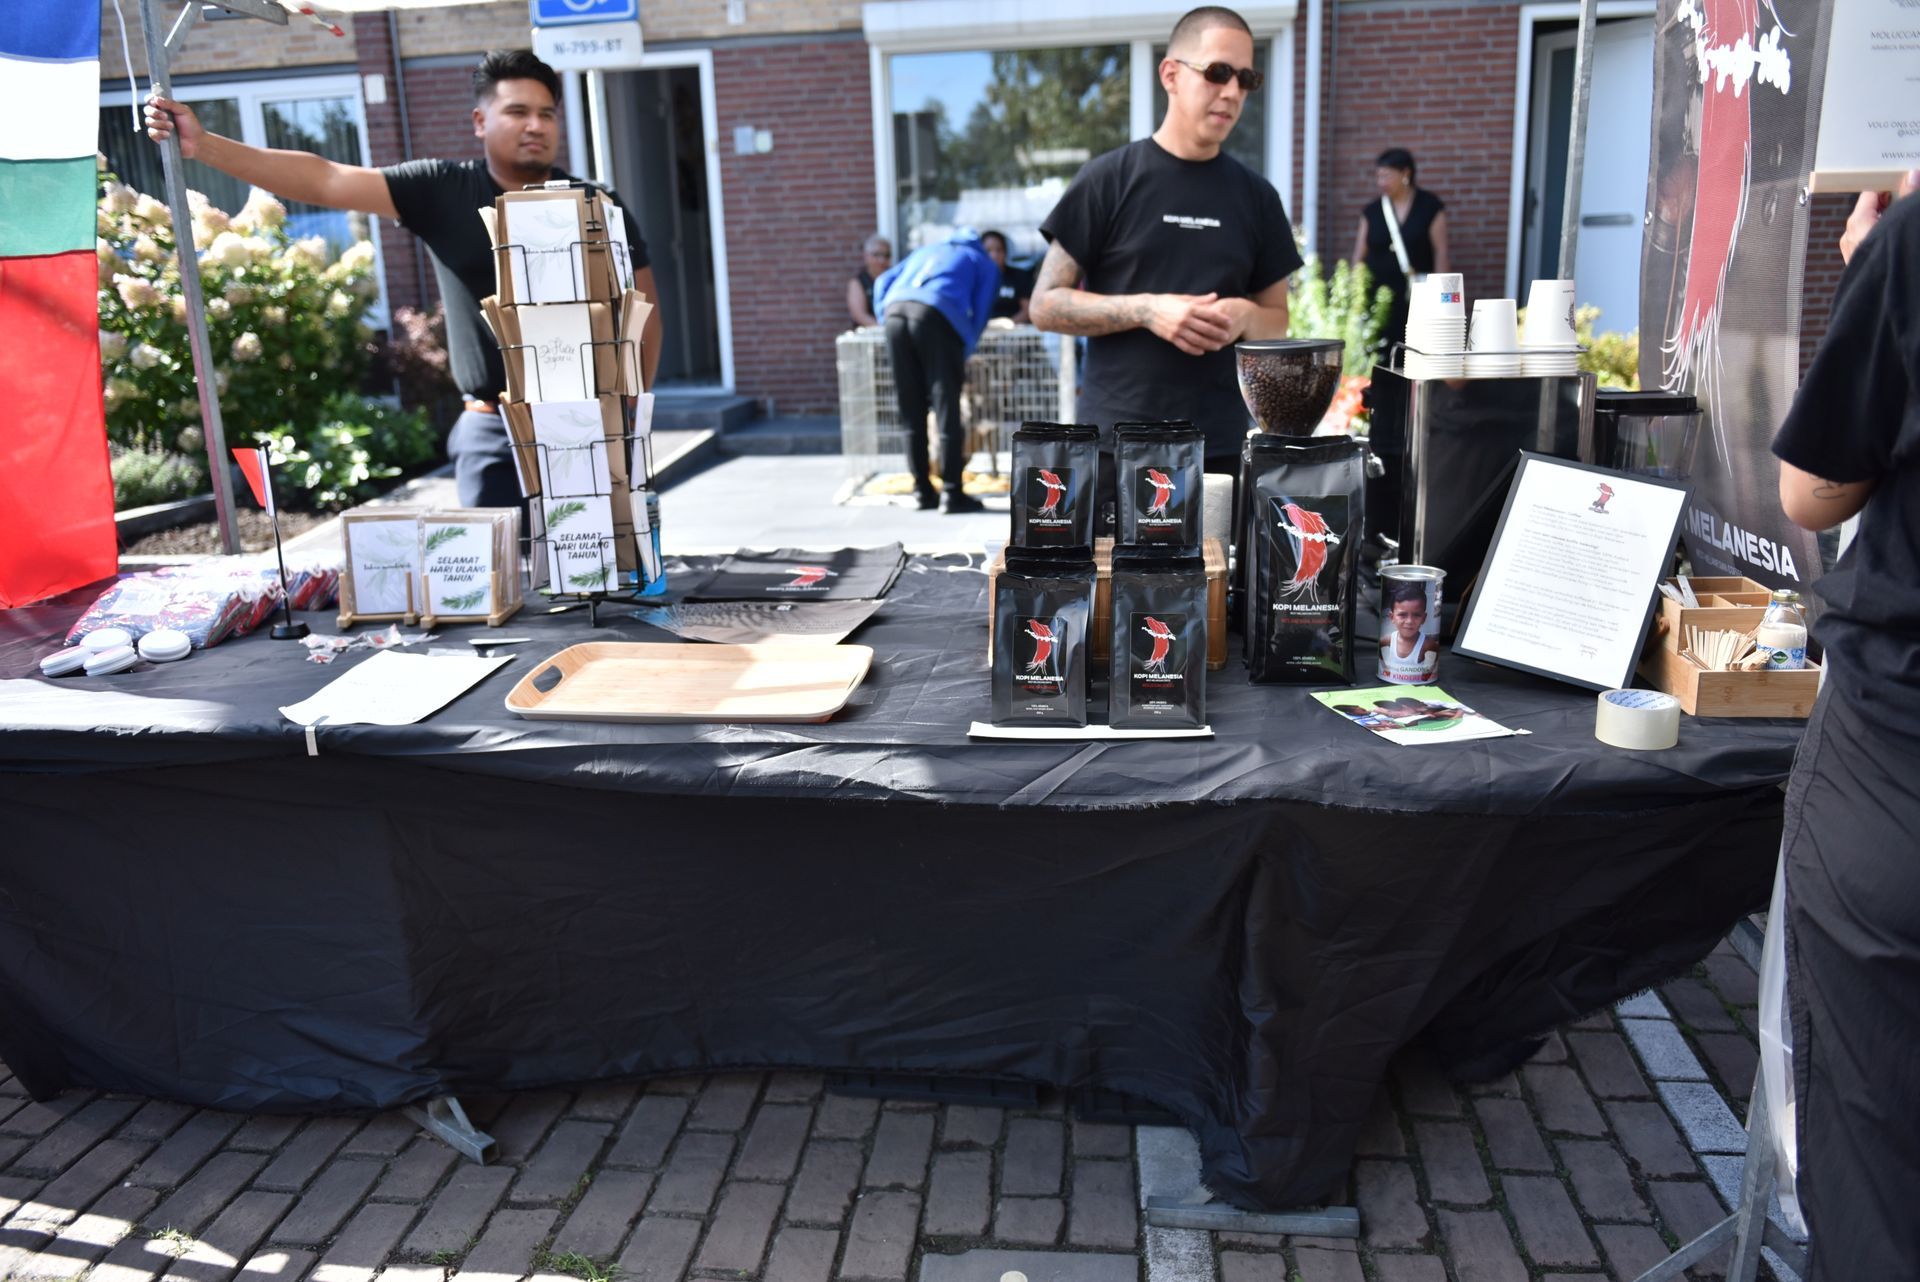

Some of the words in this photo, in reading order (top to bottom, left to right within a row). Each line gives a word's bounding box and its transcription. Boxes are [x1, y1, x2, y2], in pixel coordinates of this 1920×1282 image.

[560, 532, 602, 541] SELAMAT
[1688, 505, 1800, 581] MELANESIA
[568, 551, 598, 559] TAHUN
[437, 556, 480, 564] SELAMAT
